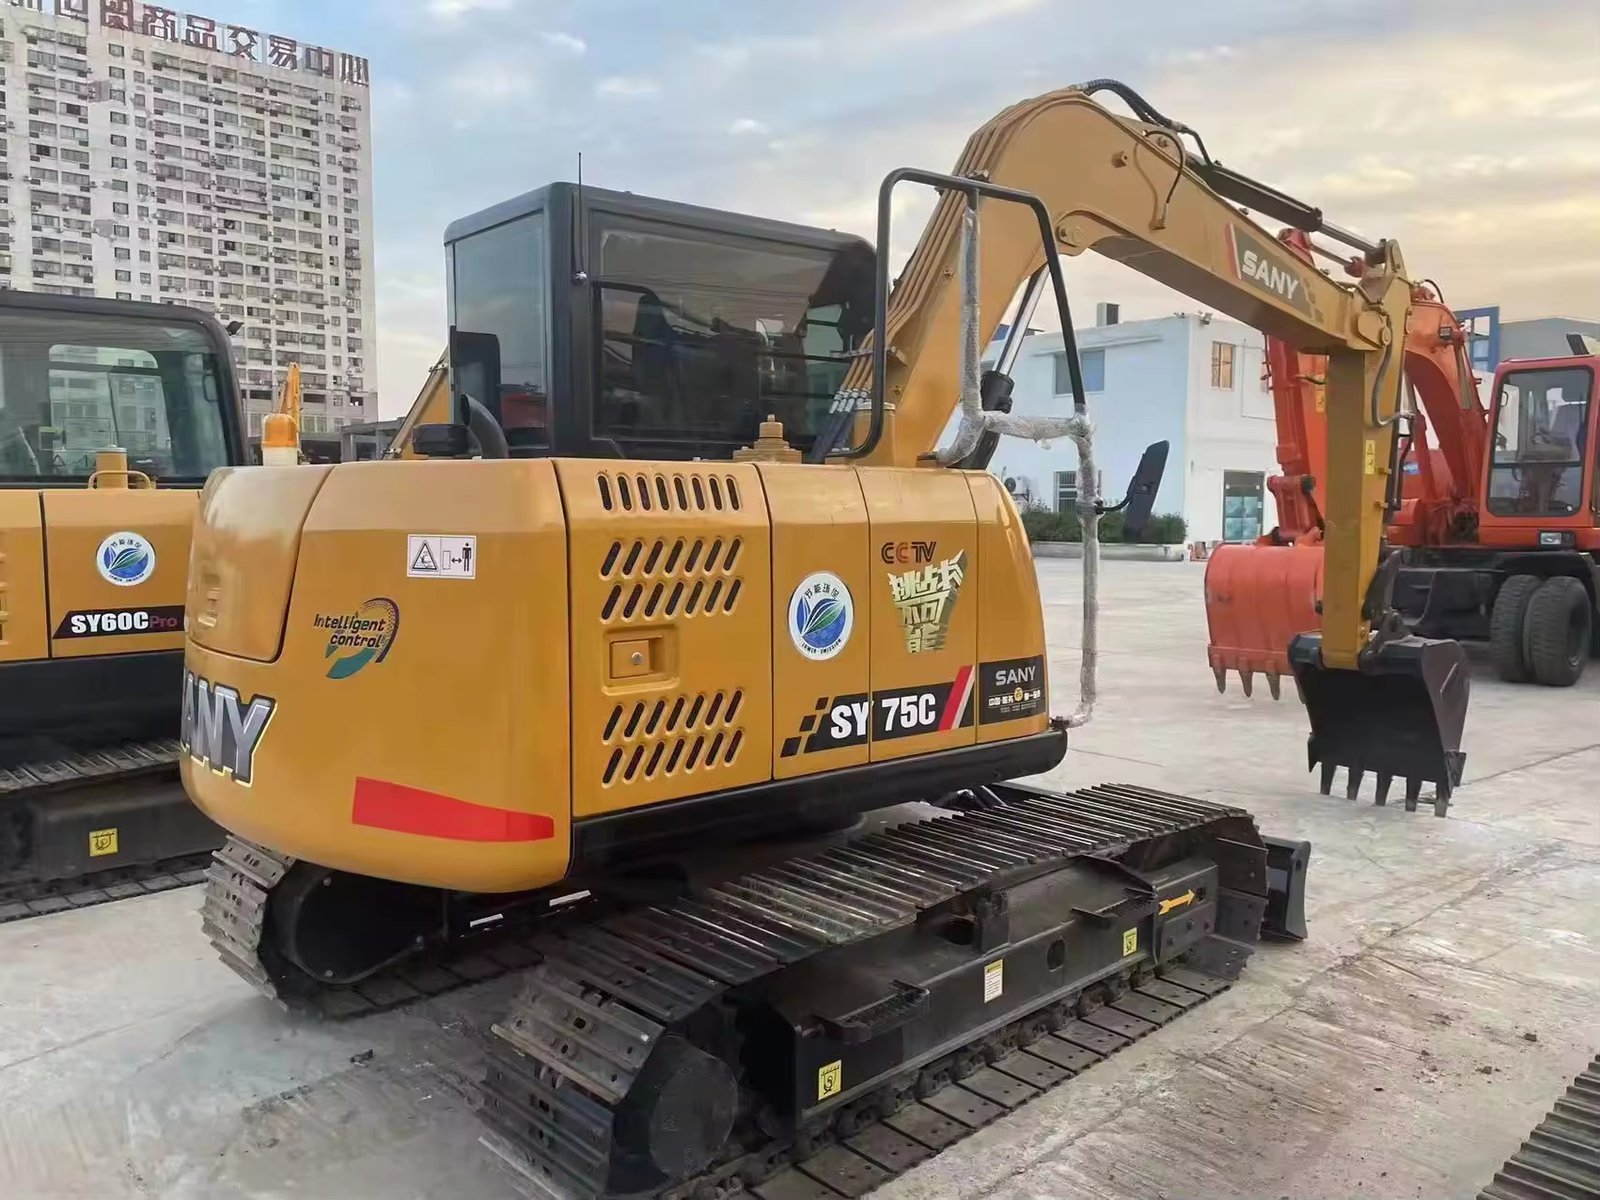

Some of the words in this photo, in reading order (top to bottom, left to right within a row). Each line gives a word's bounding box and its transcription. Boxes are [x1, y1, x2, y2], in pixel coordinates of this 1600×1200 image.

[1241, 249, 1299, 300] SANY
[881, 541, 937, 565] CCTV
[70, 611, 149, 634] SY60C
[149, 615, 178, 628] Pro
[313, 611, 387, 634] Intelligent
[330, 634, 382, 648] control
[995, 665, 1036, 687] SANY
[182, 670, 277, 788] ANY
